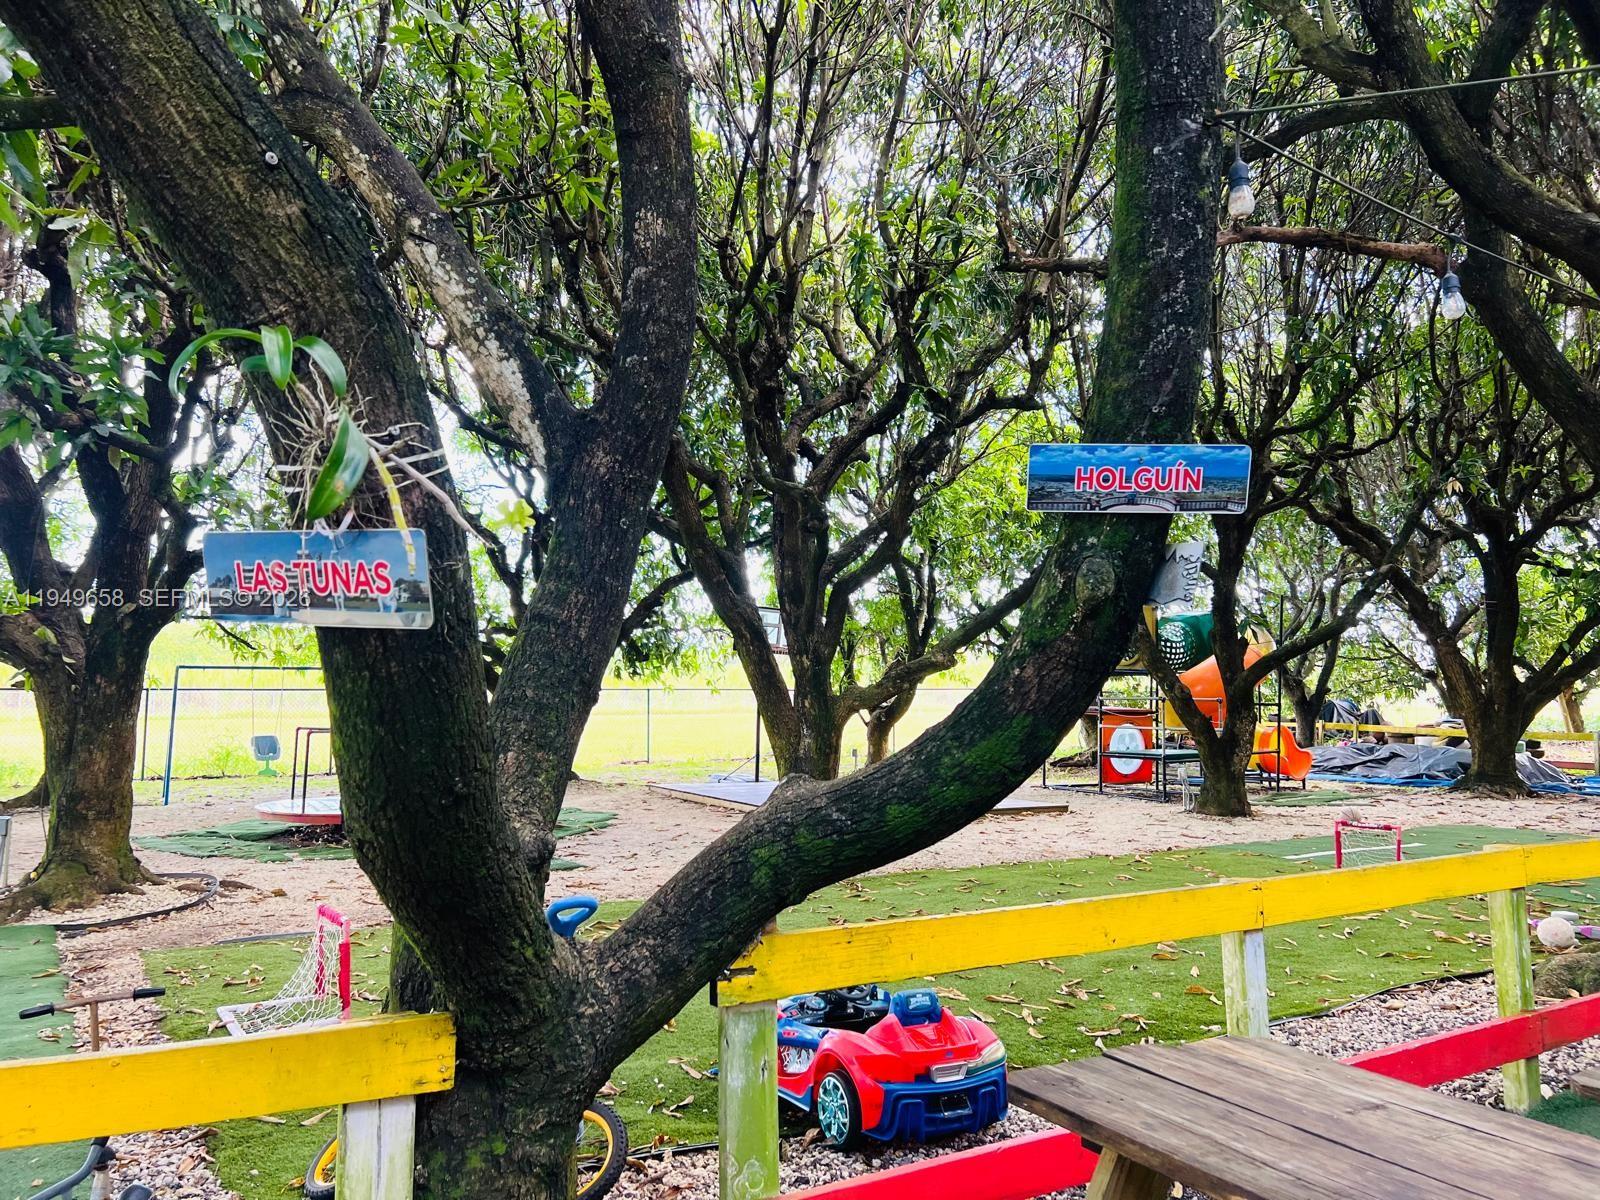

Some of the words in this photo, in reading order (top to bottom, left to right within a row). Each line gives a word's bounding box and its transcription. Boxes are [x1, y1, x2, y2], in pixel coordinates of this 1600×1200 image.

[1075, 460, 1203, 492] HOLGUÍN
[234, 560, 289, 593] LAS
[290, 560, 393, 596] TUNAS
